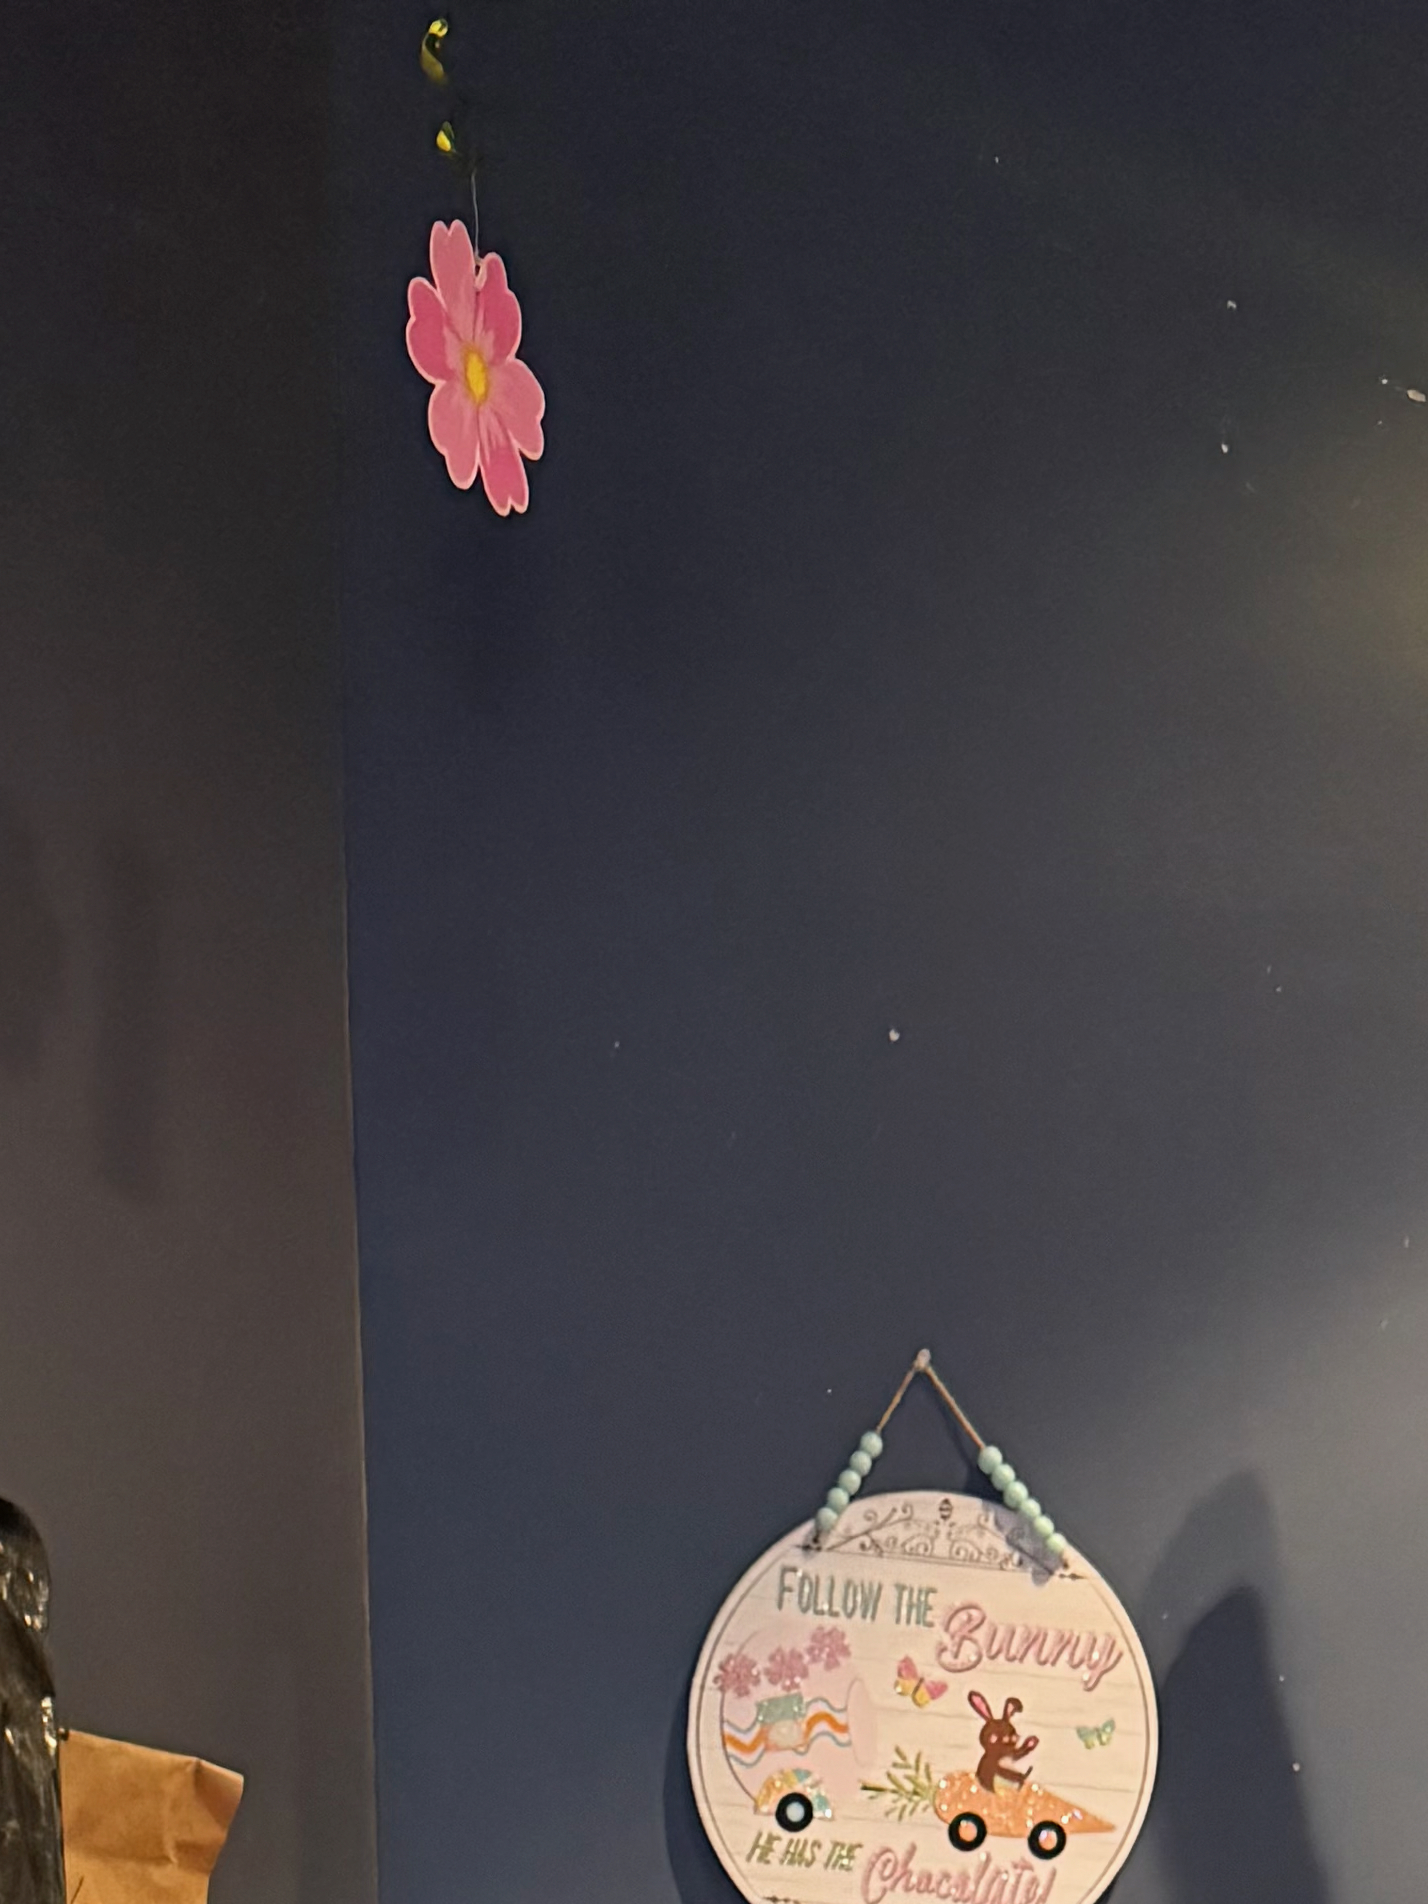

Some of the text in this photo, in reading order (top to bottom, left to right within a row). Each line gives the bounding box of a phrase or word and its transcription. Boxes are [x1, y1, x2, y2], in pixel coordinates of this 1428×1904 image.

[777, 1564, 1124, 1691] FOLLOW THE Bunny
[746, 1831, 779, 1867] HE
[783, 1835, 817, 1870] HAS
[824, 1840, 864, 1872] THE
